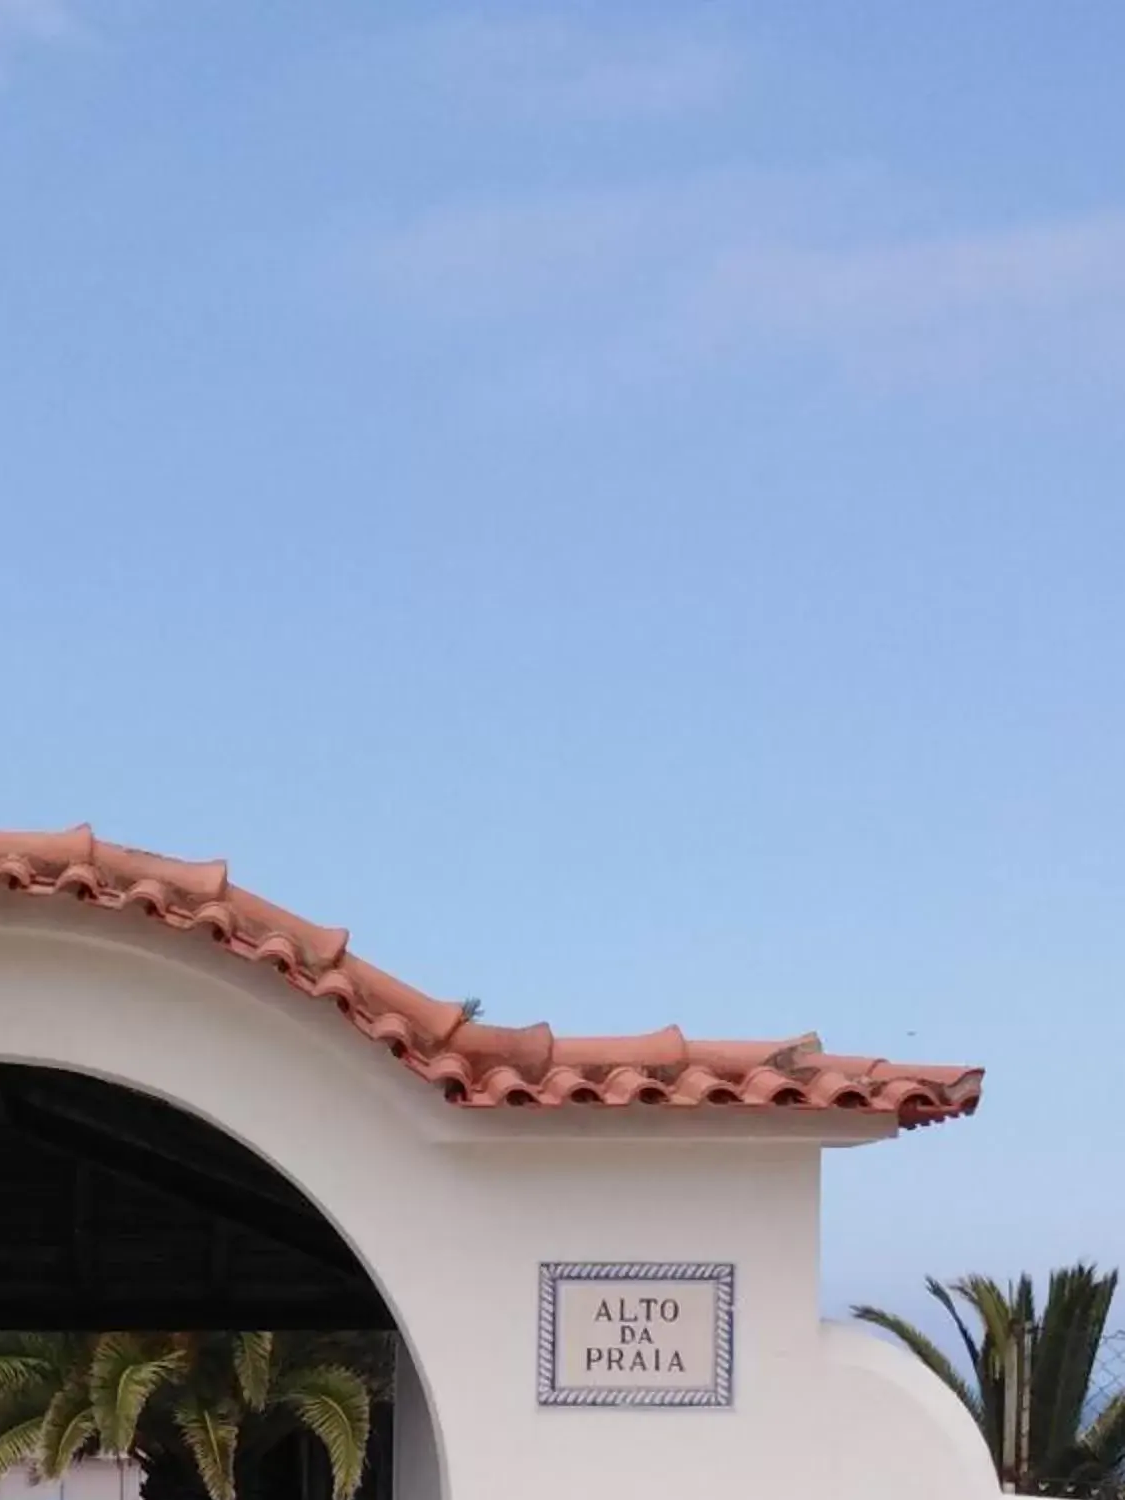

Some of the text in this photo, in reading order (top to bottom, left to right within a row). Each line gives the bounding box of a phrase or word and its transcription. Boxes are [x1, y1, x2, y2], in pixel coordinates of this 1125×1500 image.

[594, 1297, 680, 1323] ALTO
[620, 1325, 654, 1344] DA
[586, 1347, 686, 1372] PRAIA
